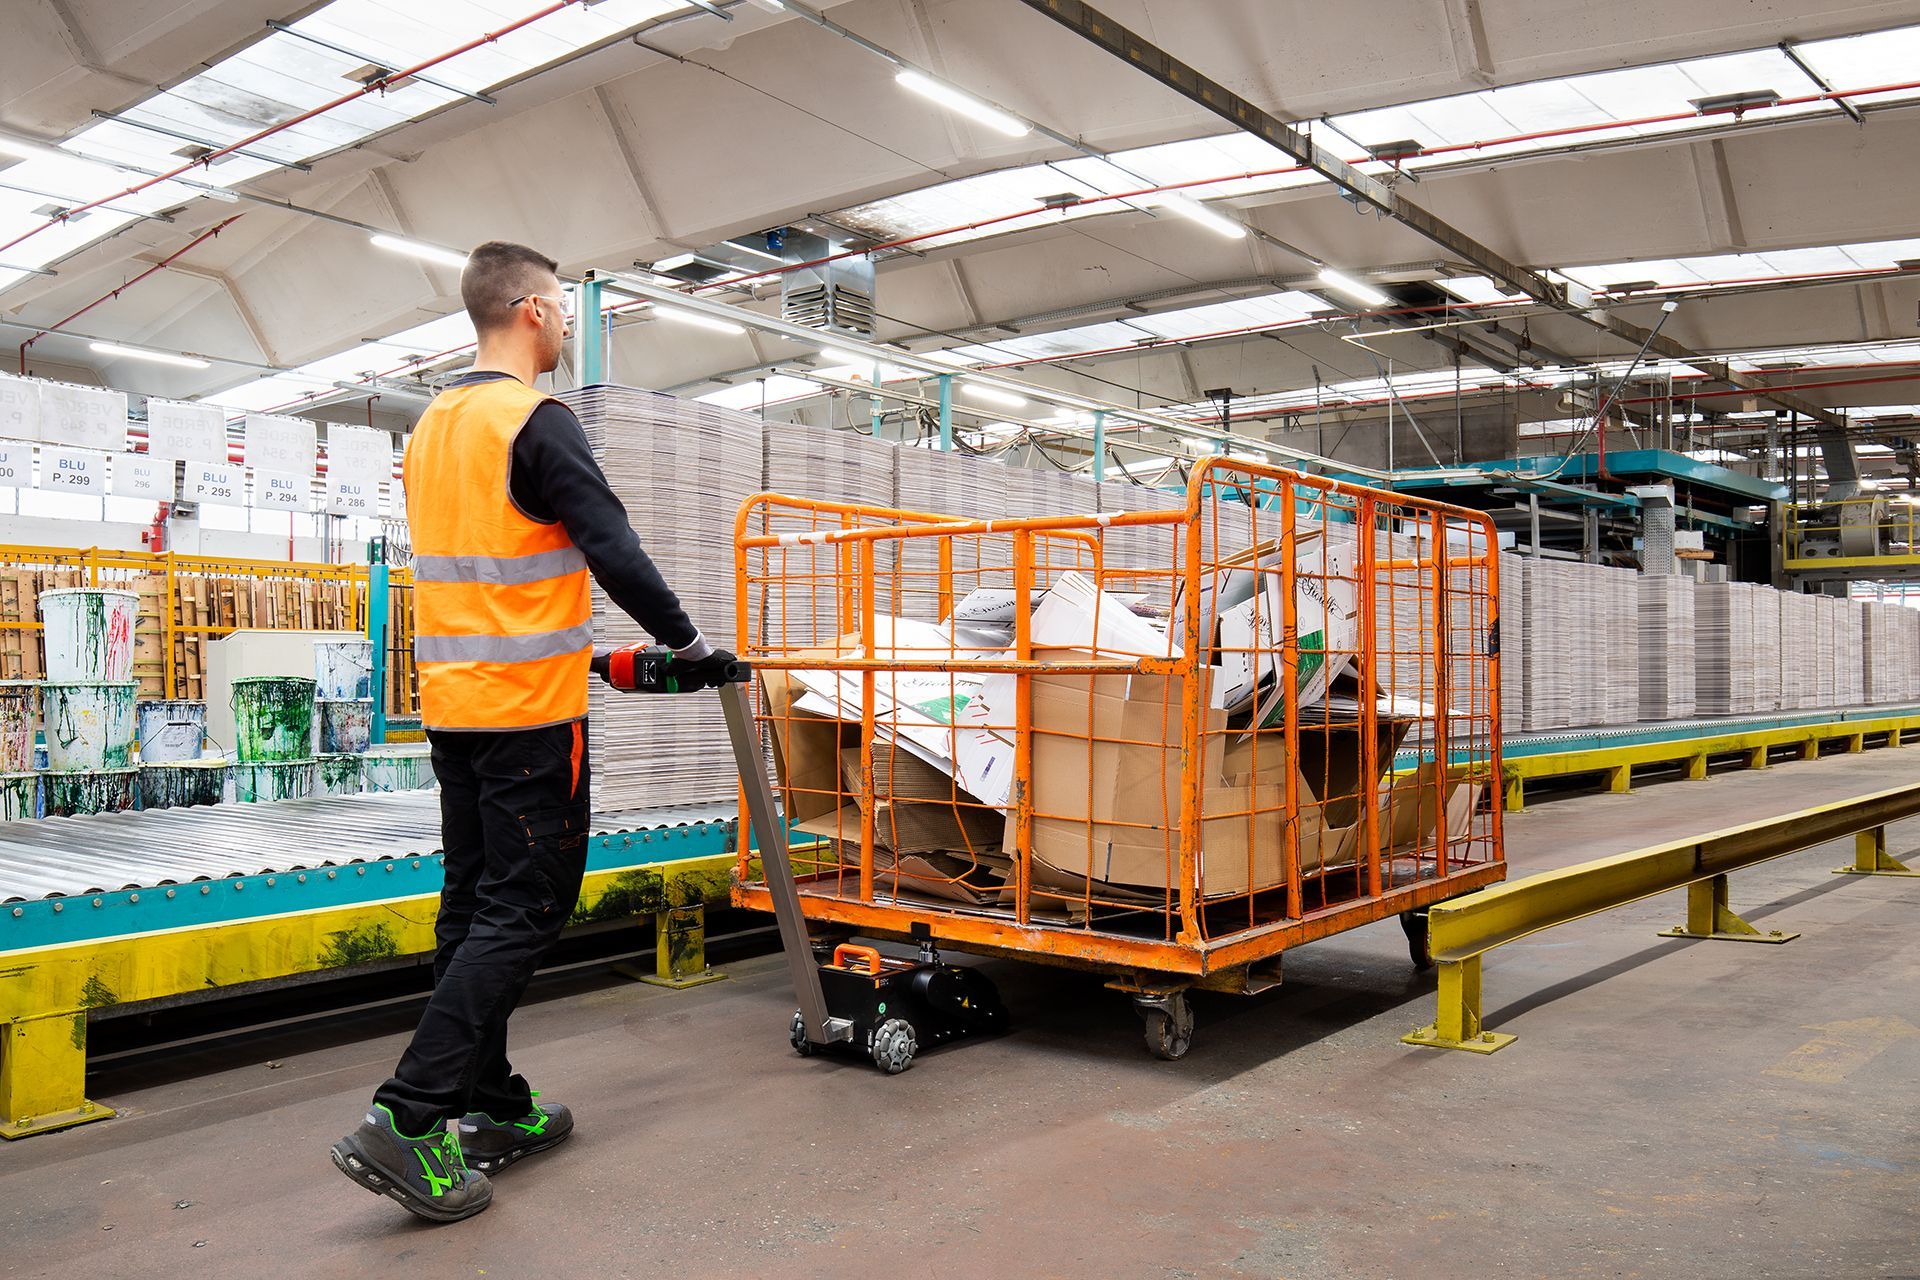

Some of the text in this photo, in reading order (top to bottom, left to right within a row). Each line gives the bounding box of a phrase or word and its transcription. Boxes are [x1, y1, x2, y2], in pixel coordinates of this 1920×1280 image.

[59, 458, 86, 471] BLU
[134, 468, 150, 477] BLU
[203, 471, 227, 484] BLU
[52, 472, 90, 486] P. 299
[134, 480, 150, 489] 296
[271, 478, 293, 490] BLU
[197, 484, 232, 498] P. 295
[340, 484, 361, 495] BLU
[265, 491, 298, 503] P. 294
[336, 496, 365, 508] P. 286
